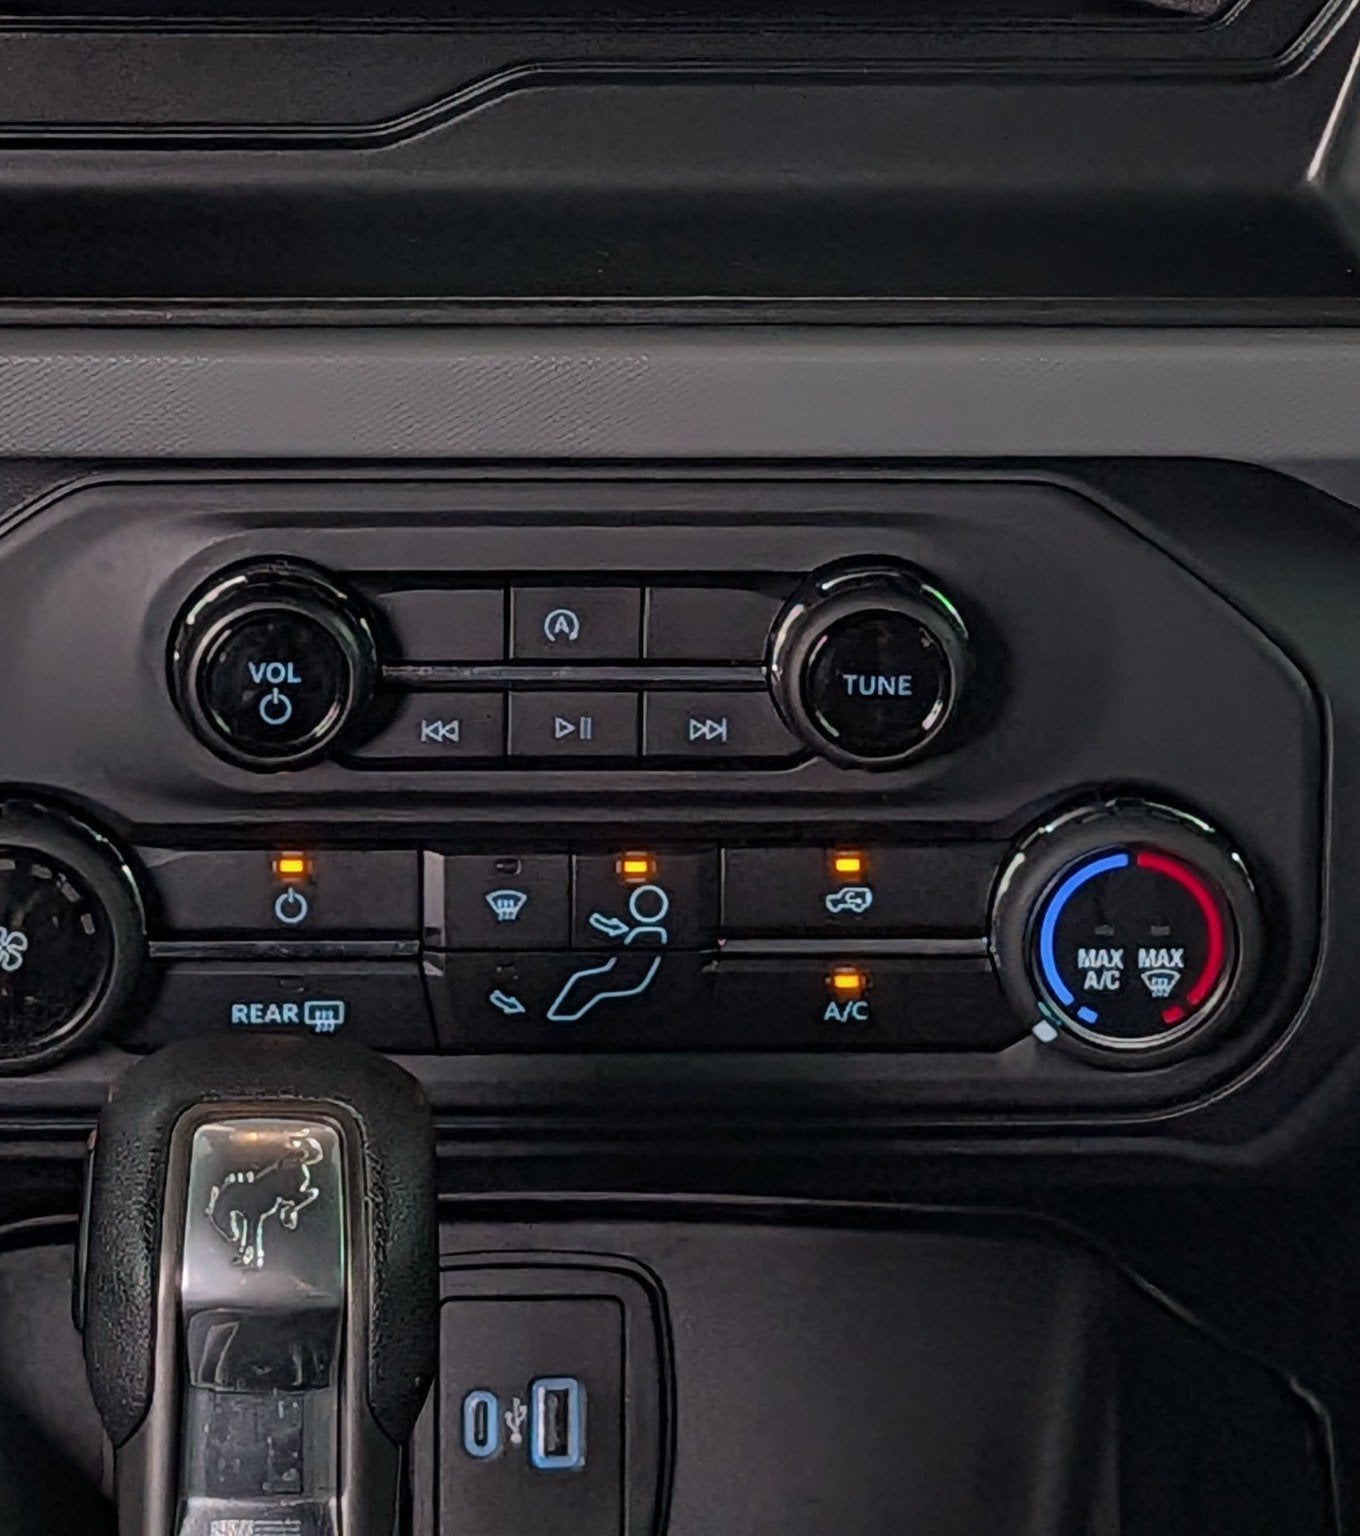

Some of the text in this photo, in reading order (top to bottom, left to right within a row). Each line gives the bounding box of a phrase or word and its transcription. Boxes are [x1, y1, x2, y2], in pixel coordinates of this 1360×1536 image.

[248, 662, 302, 683] VOL
[843, 674, 913, 696] TUNE
[1077, 948, 1124, 969] MAX
[1138, 948, 1184, 968] MAX
[1083, 969, 1120, 990] A/C
[231, 1003, 300, 1024] REAR
[823, 1001, 869, 1023] A/C
